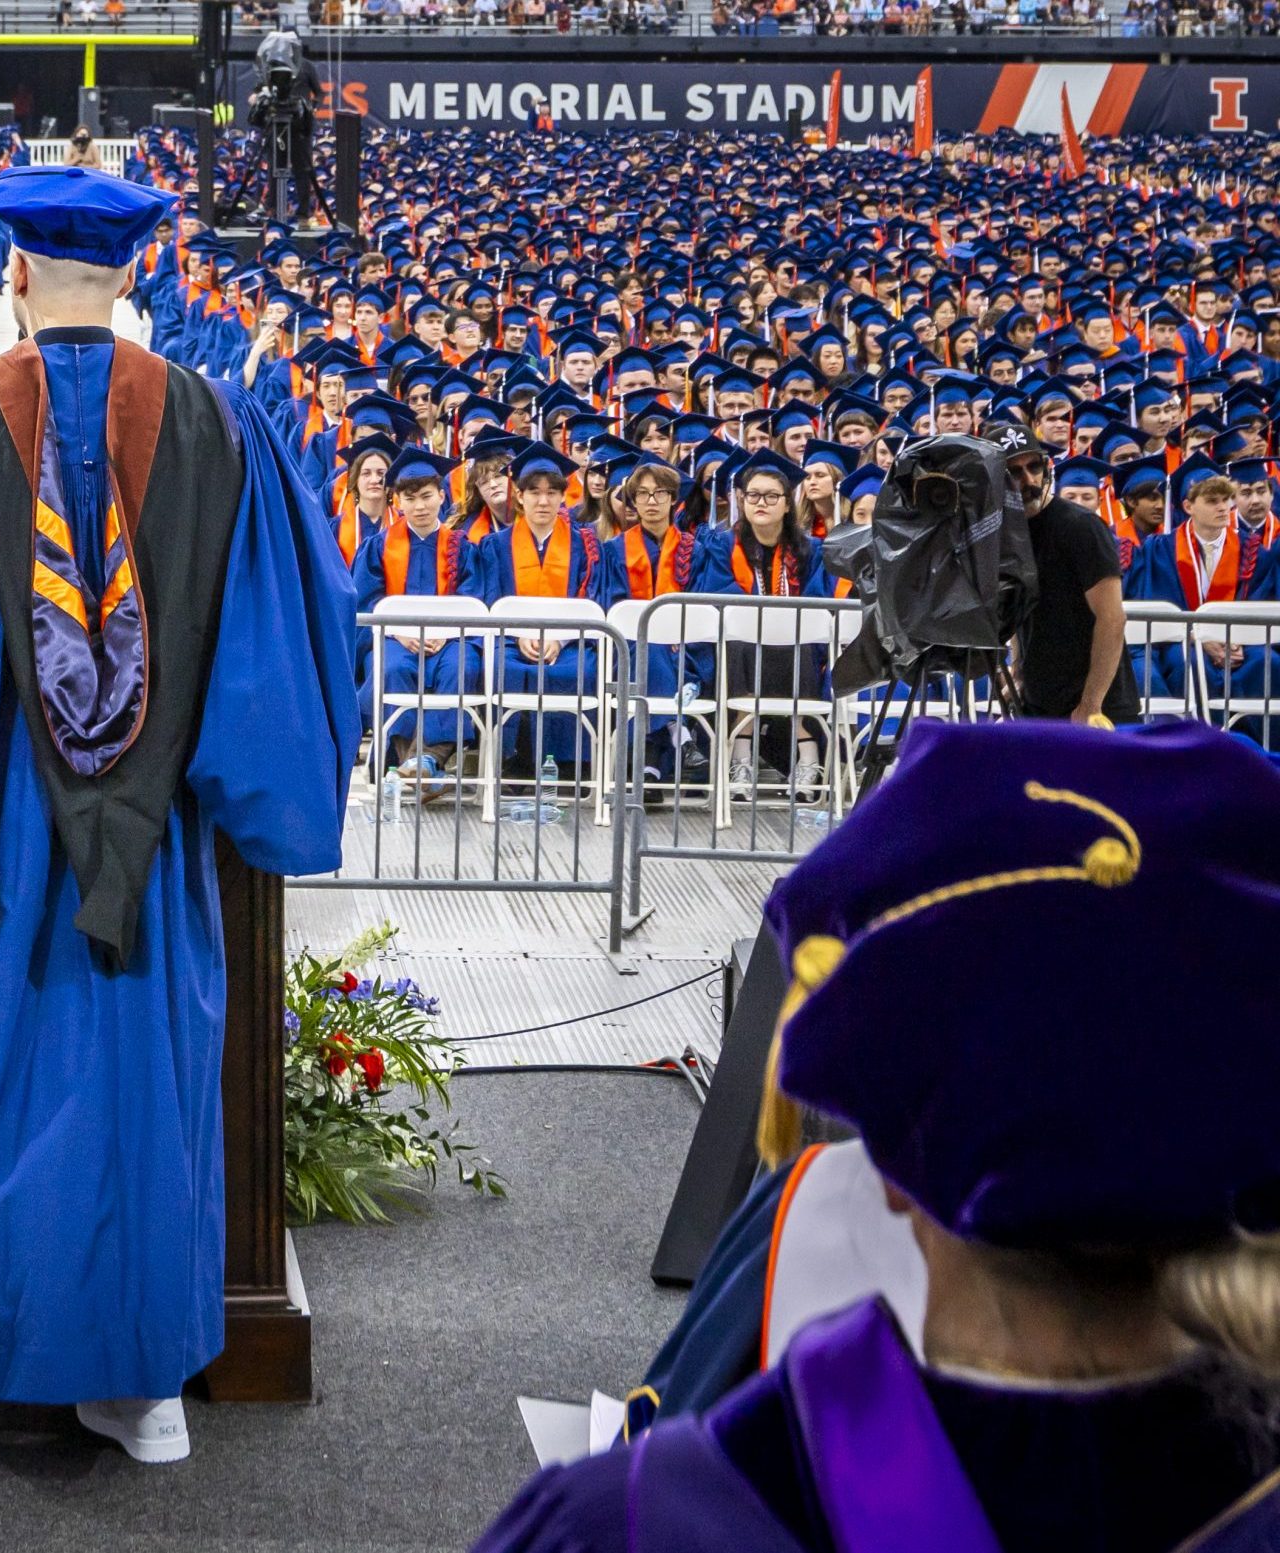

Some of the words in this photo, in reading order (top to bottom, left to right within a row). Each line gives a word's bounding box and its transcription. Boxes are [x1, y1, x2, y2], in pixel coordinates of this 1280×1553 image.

[388, 82, 667, 121] MEMORIAL
[685, 83, 917, 122] STADIUM
[1209, 78, 1248, 131] I
[158, 1424, 177, 1435] SCE
